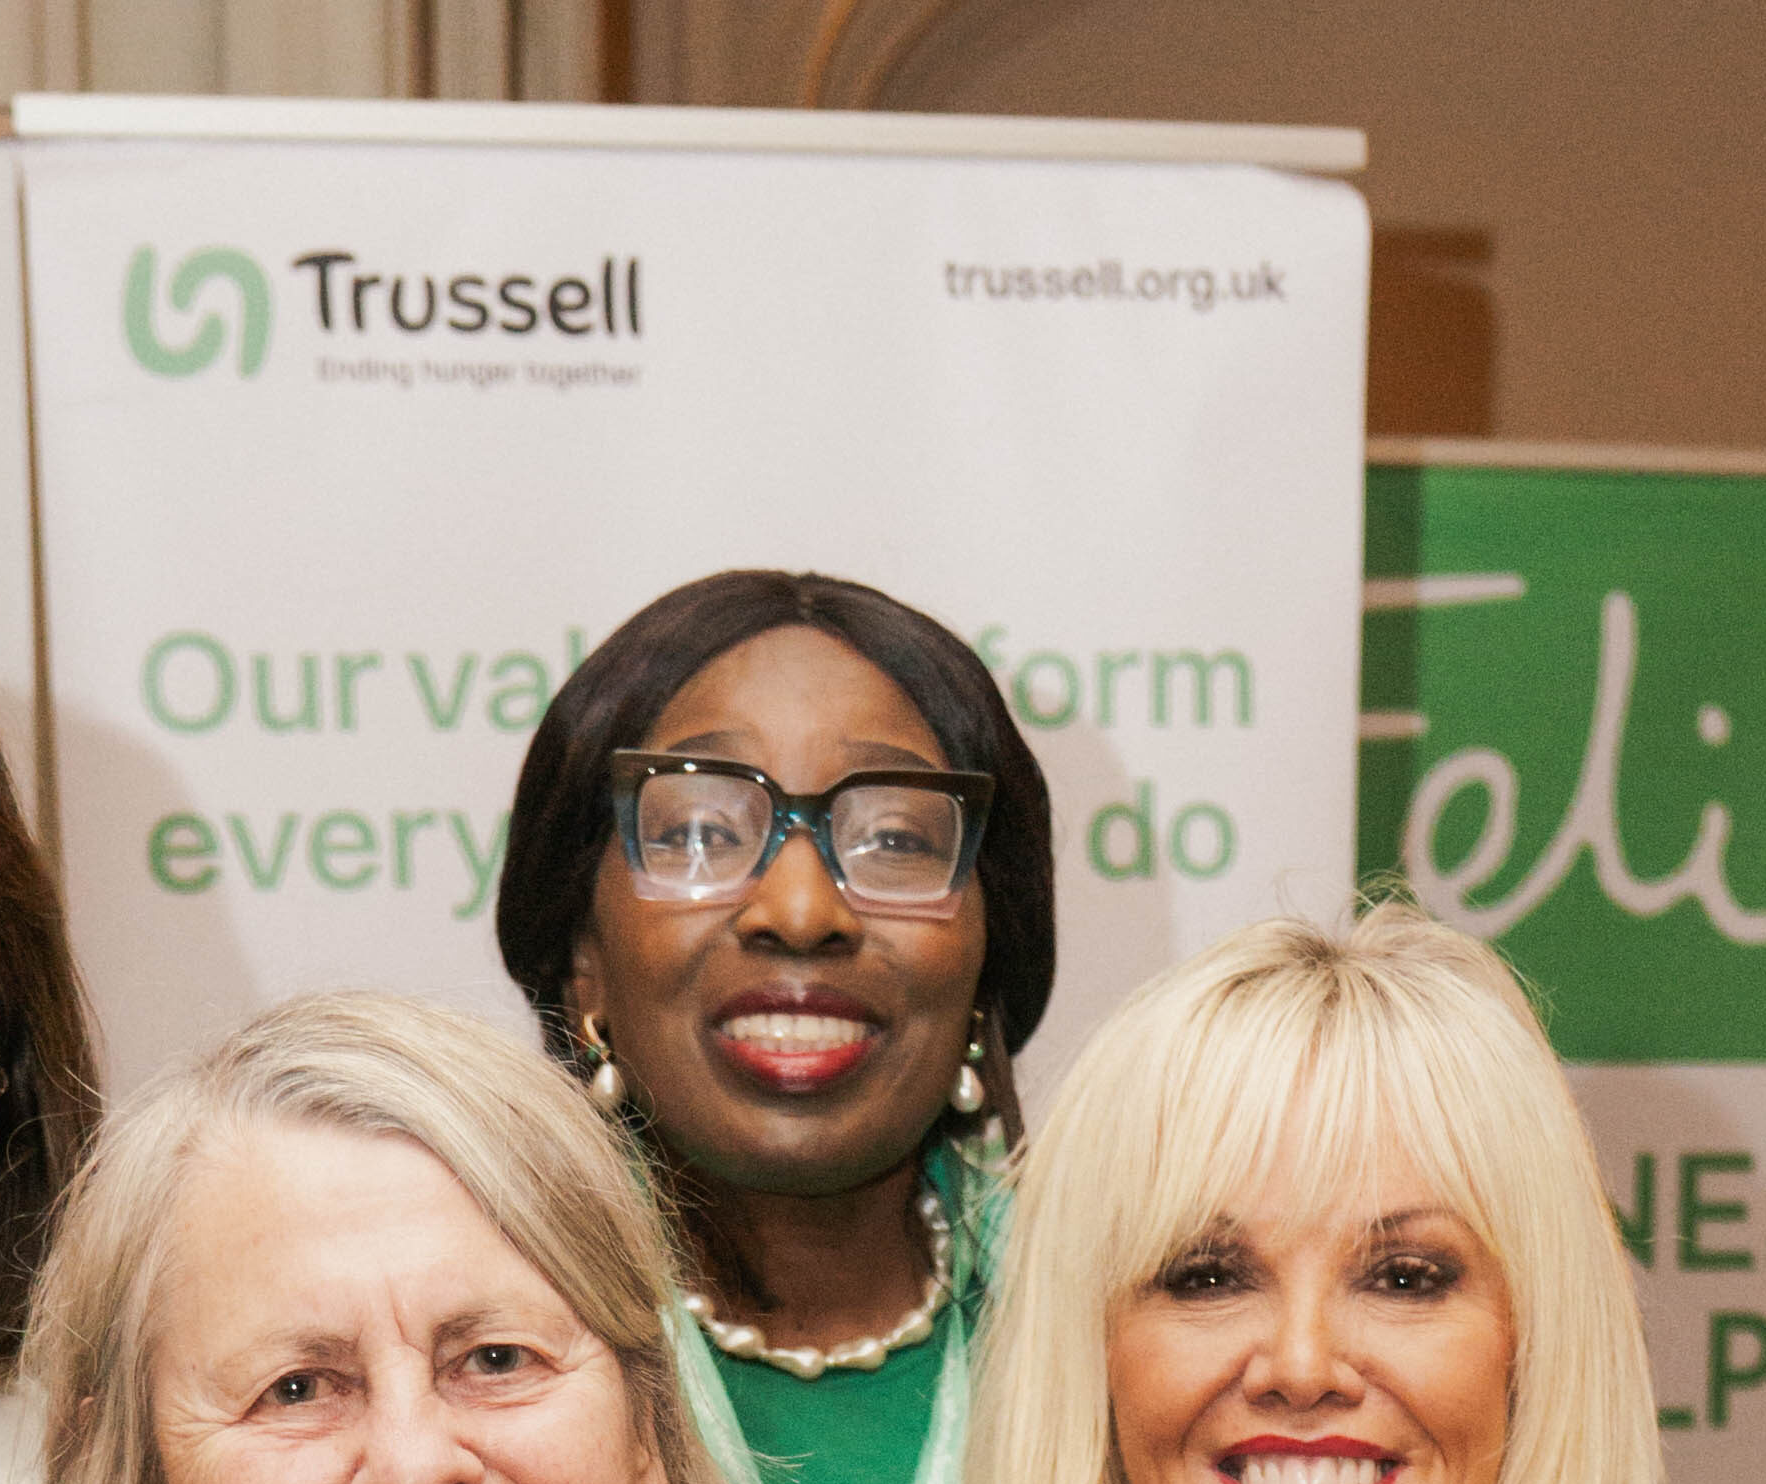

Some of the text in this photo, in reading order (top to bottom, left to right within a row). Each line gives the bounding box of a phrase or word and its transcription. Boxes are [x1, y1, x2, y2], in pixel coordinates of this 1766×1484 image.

[293, 250, 642, 336] Trussell
[945, 260, 1287, 314] trussell.org.uk
[141, 629, 383, 736] Our
[1087, 778, 1238, 882] do
